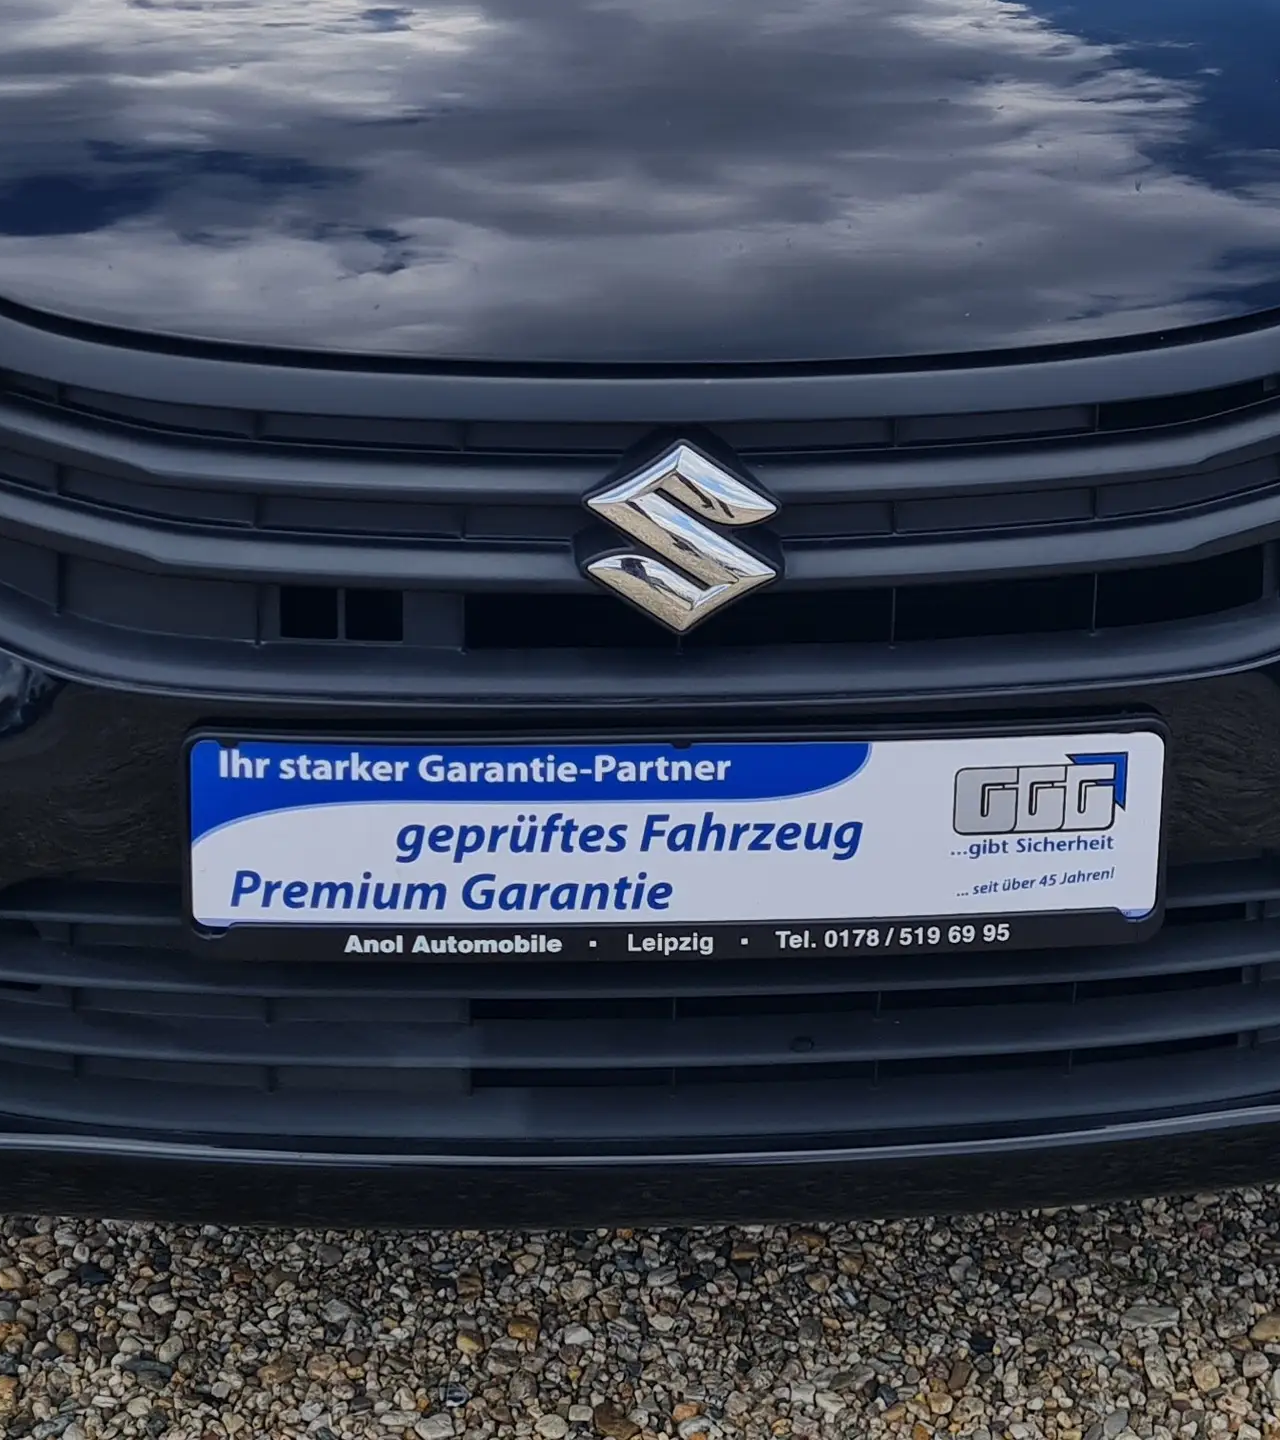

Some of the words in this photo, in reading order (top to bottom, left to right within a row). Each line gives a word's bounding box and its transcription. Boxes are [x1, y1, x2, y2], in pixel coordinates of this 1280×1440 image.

[219, 749, 270, 779] Ihr
[279, 752, 409, 782] starker
[418, 754, 732, 783] Garantie-Partner
[395, 812, 628, 864] geprüftes
[640, 811, 864, 861] Fahrzeug
[1016, 835, 1115, 854] Sicherheit
[230, 869, 448, 910] Premium
[462, 871, 673, 911] Garantie
[972, 880, 999, 896] seit
[1002, 878, 1036, 893] über
[1038, 873, 1058, 888] 45
[1059, 866, 1115, 886] Jahren!
[344, 934, 404, 954] Anol
[412, 934, 563, 954] Automobile
[627, 932, 714, 956] Leipzig
[775, 930, 817, 949] Tel.
[948, 924, 976, 945] 69
[983, 922, 1010, 943] 95
